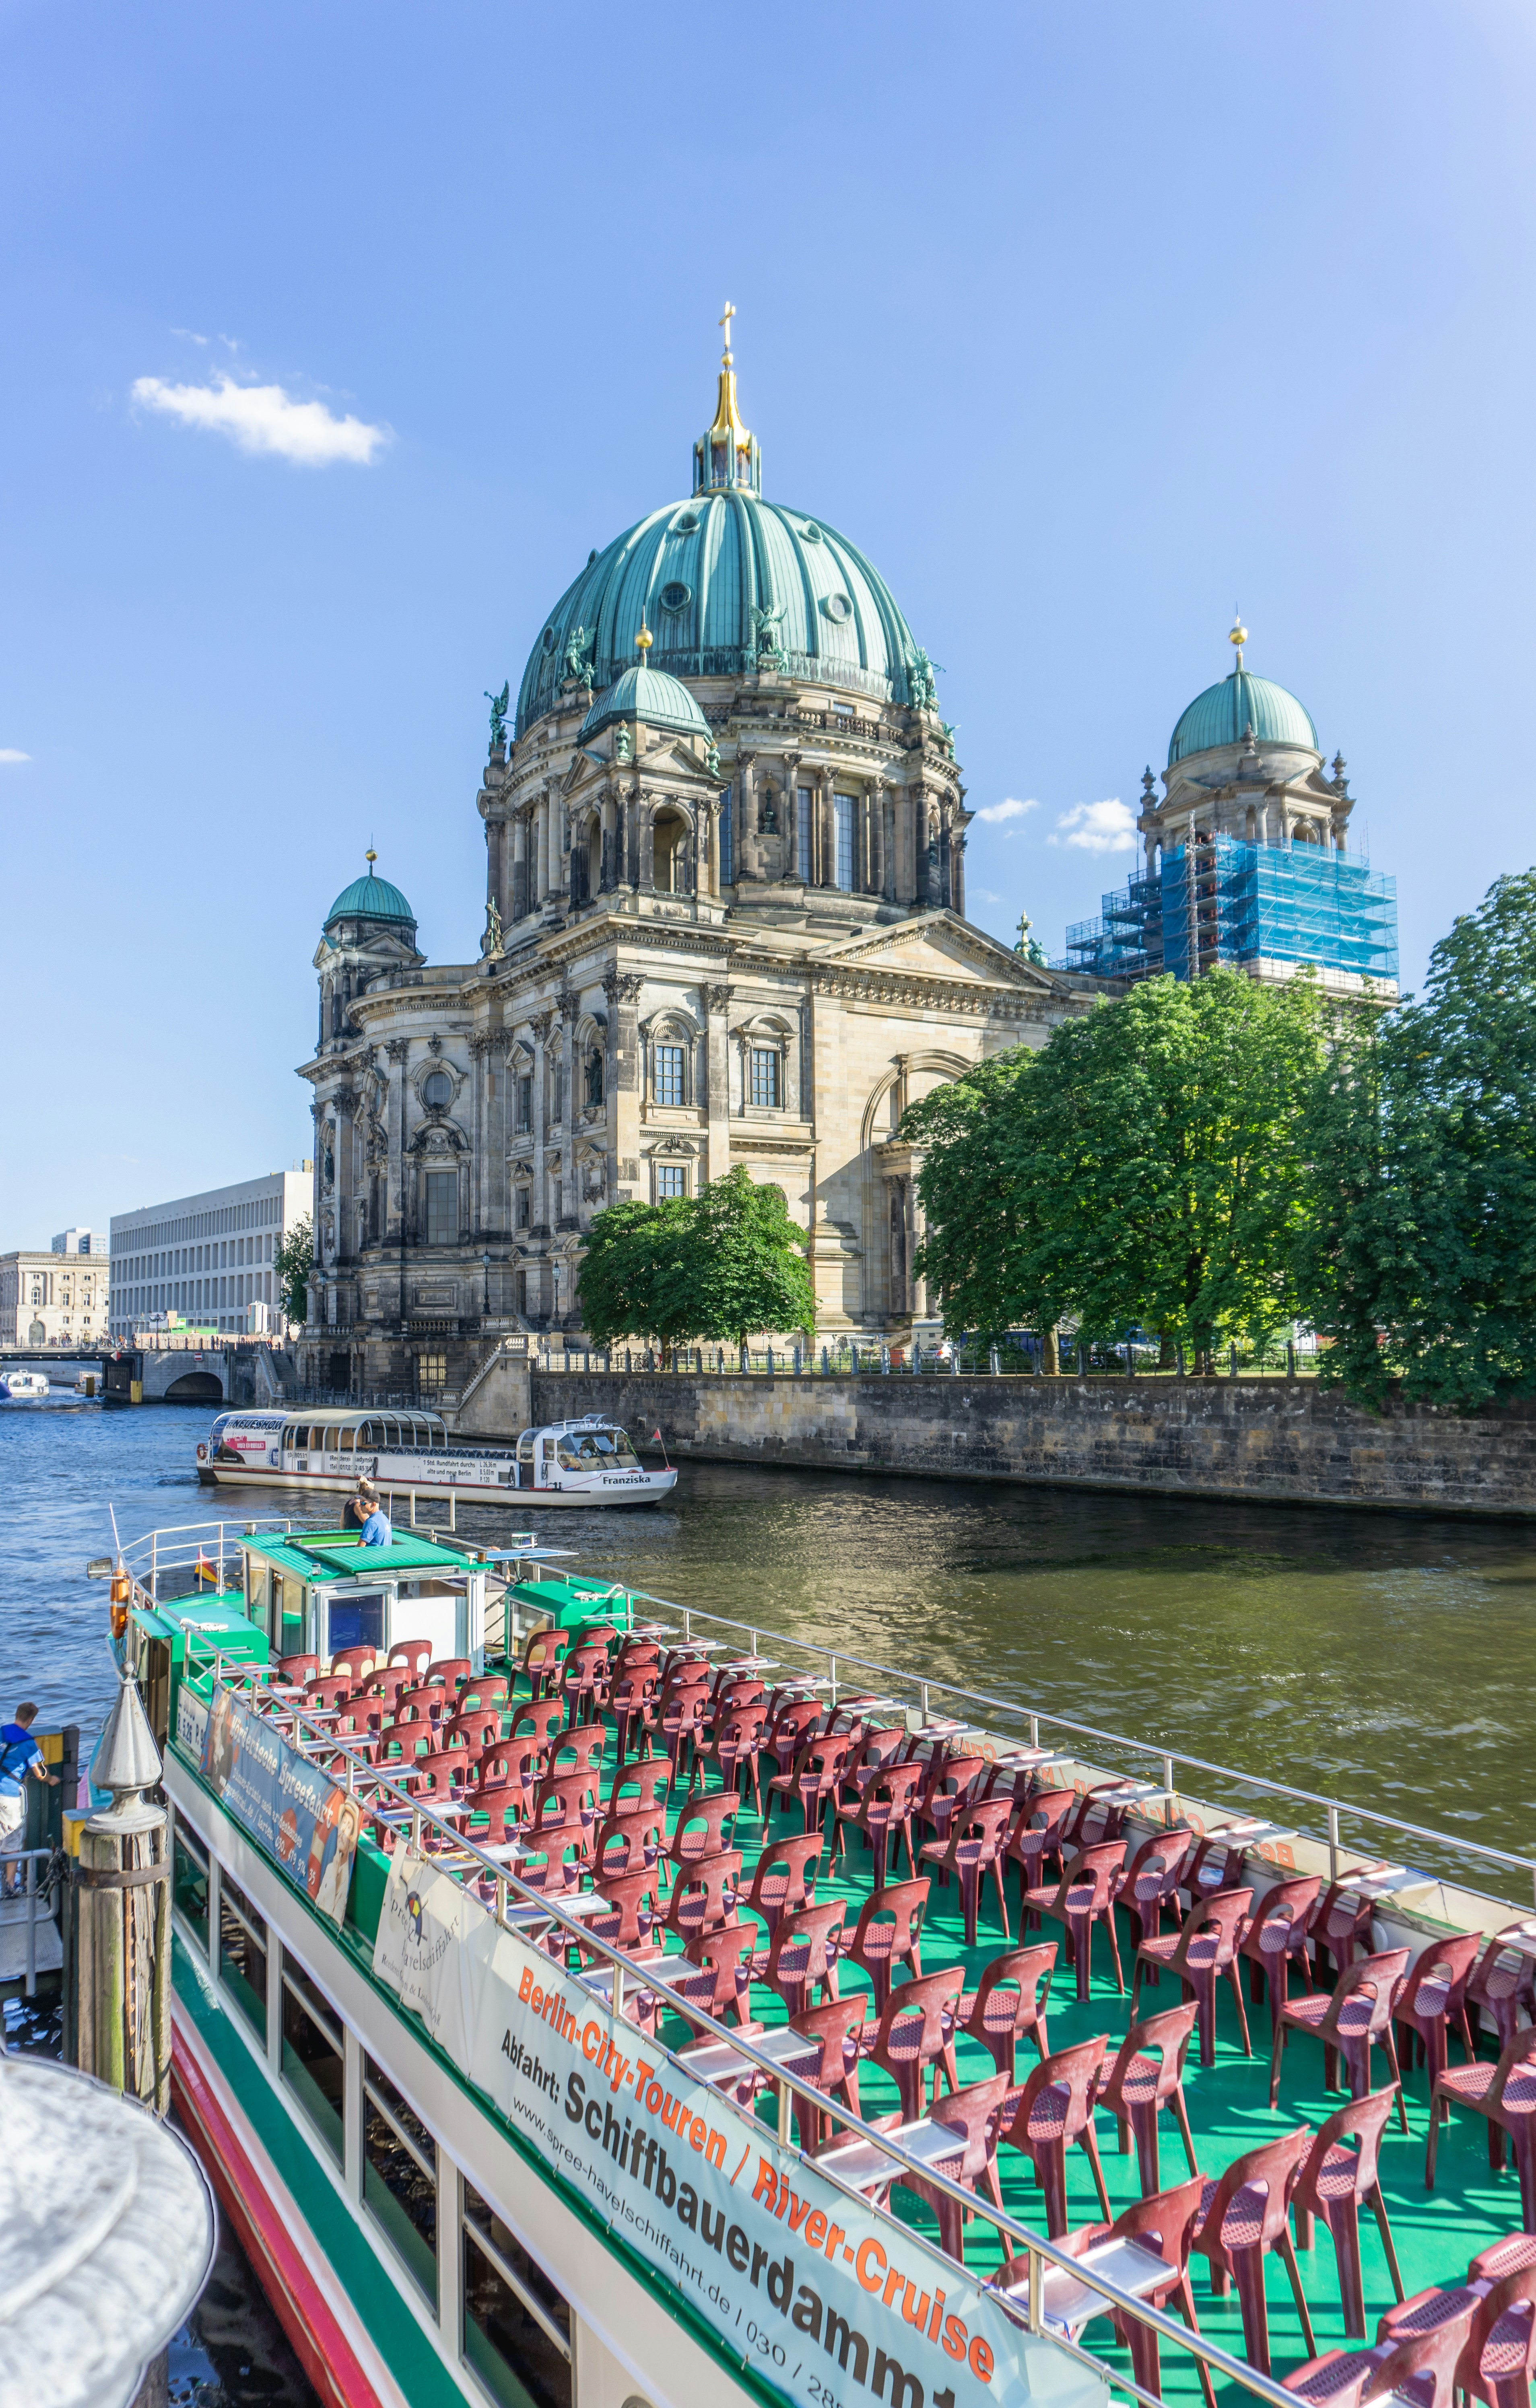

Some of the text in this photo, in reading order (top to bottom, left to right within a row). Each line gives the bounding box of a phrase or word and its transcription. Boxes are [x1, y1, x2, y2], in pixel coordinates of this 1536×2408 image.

[603, 1475, 651, 1484] Franziska
[230, 1715, 333, 1829] Mörderische Spreefahrt
[308, 1868, 316, 1886] 35
[501, 2029, 560, 2105] Abfahrt:
[518, 1965, 728, 2170] Berlin-City-Touren
[752, 2156, 994, 2383] River-Cruise
[513, 2097, 730, 2315] www.spree-havelschiffahrt.de
[746, 2321, 786, 2367] 030
[807, 2375, 842, 2408] 28
